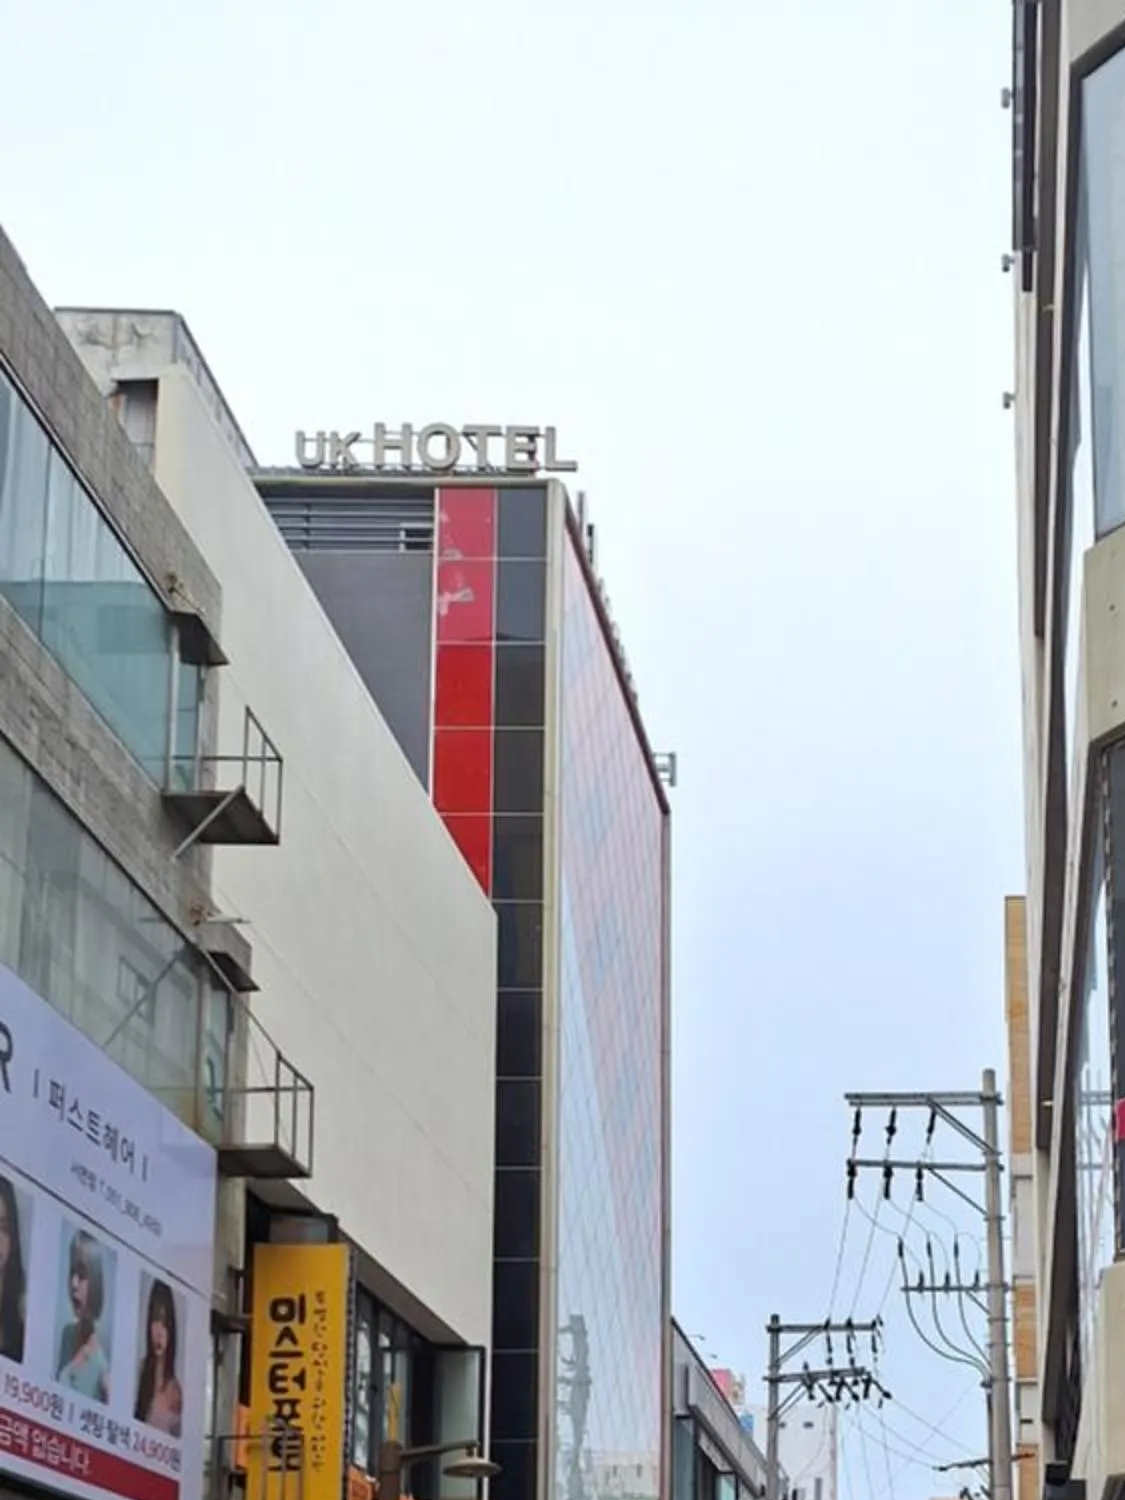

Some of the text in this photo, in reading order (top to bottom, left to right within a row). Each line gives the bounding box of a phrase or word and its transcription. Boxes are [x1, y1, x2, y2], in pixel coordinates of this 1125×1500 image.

[295, 422, 578, 472] UK HOTEL
[49, 1078, 135, 1175] 퍼스트헤어
